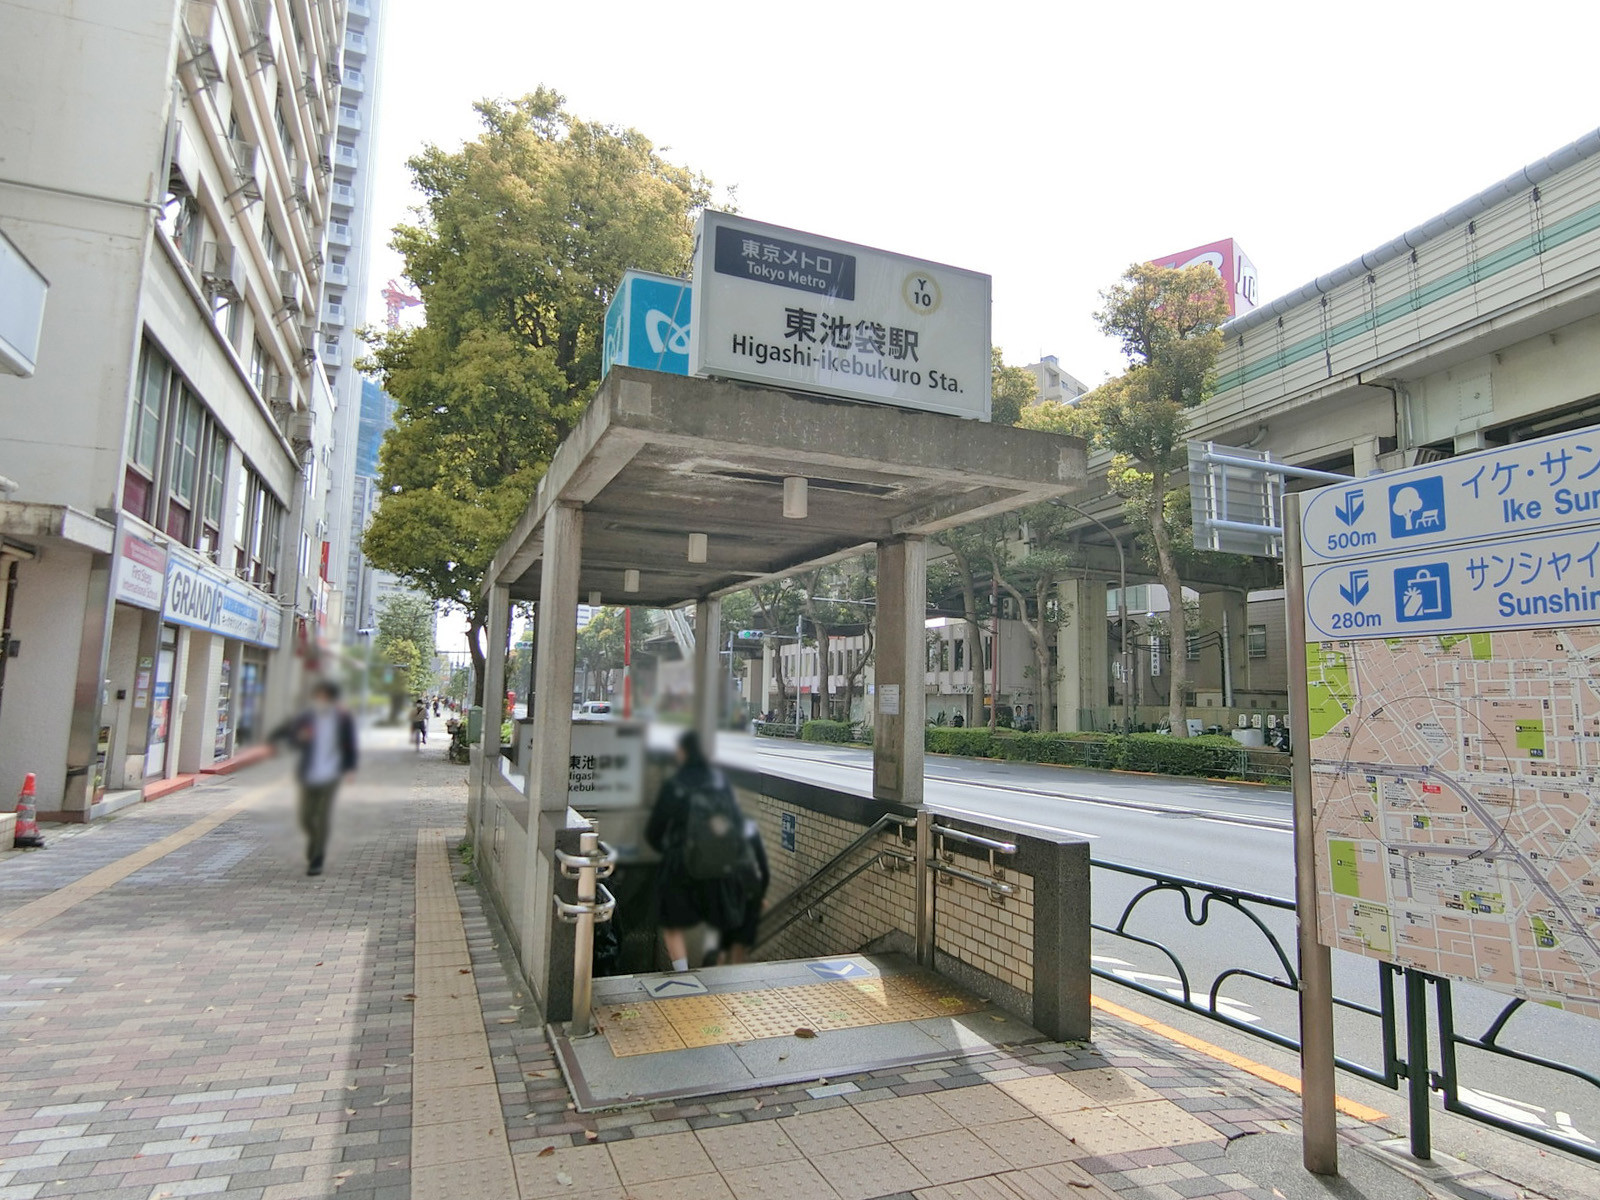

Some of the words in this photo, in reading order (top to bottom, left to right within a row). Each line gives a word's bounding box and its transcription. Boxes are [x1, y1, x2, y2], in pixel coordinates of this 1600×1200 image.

[741, 239, 832, 275] 東京メトロ
[746, 260, 785, 281] Tokyo
[788, 269, 827, 289] Metro
[917, 278, 928, 291] Y
[914, 291, 932, 307] 10
[783, 306, 919, 363] 東池袋駅
[732, 333, 922, 386] Higashi-ikebukuro
[928, 369, 964, 394] Sta.
[1502, 498, 1541, 523] Ike
[1327, 530, 1377, 551] 500m
[1331, 611, 1382, 630] 280m
